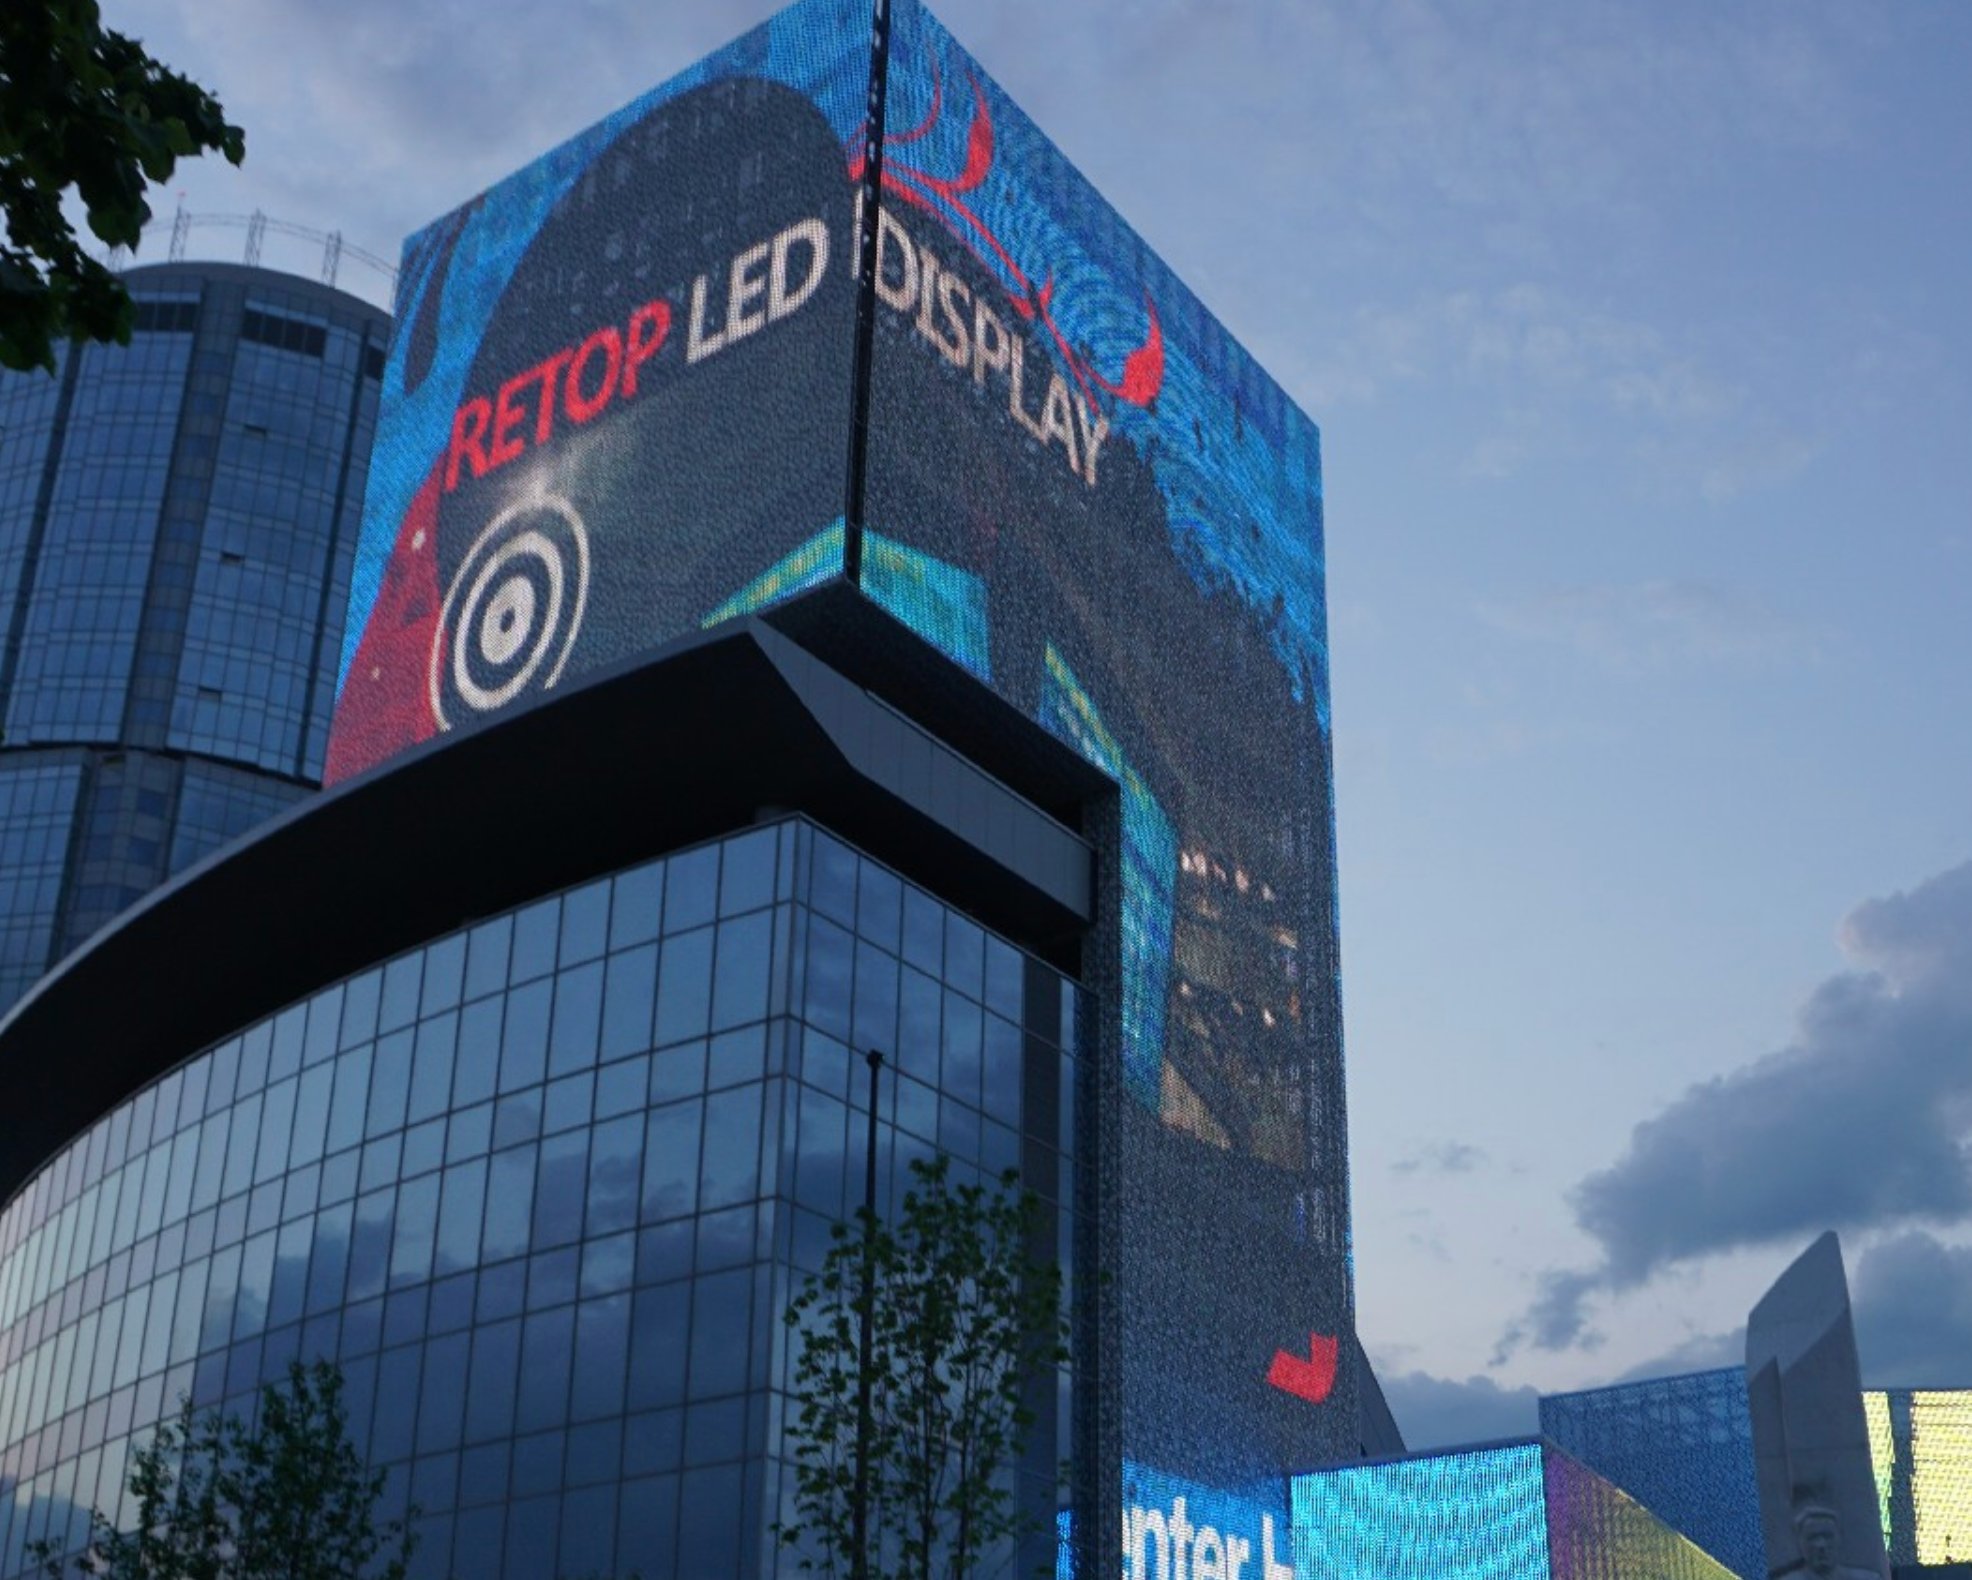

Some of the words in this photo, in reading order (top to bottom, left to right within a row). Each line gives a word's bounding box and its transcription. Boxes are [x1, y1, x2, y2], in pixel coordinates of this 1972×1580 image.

[446, 299, 672, 493] RETOP
[688, 218, 830, 364] LED
[853, 189, 1109, 487] DISPLAY
[1123, 1496, 1249, 1580] nter
